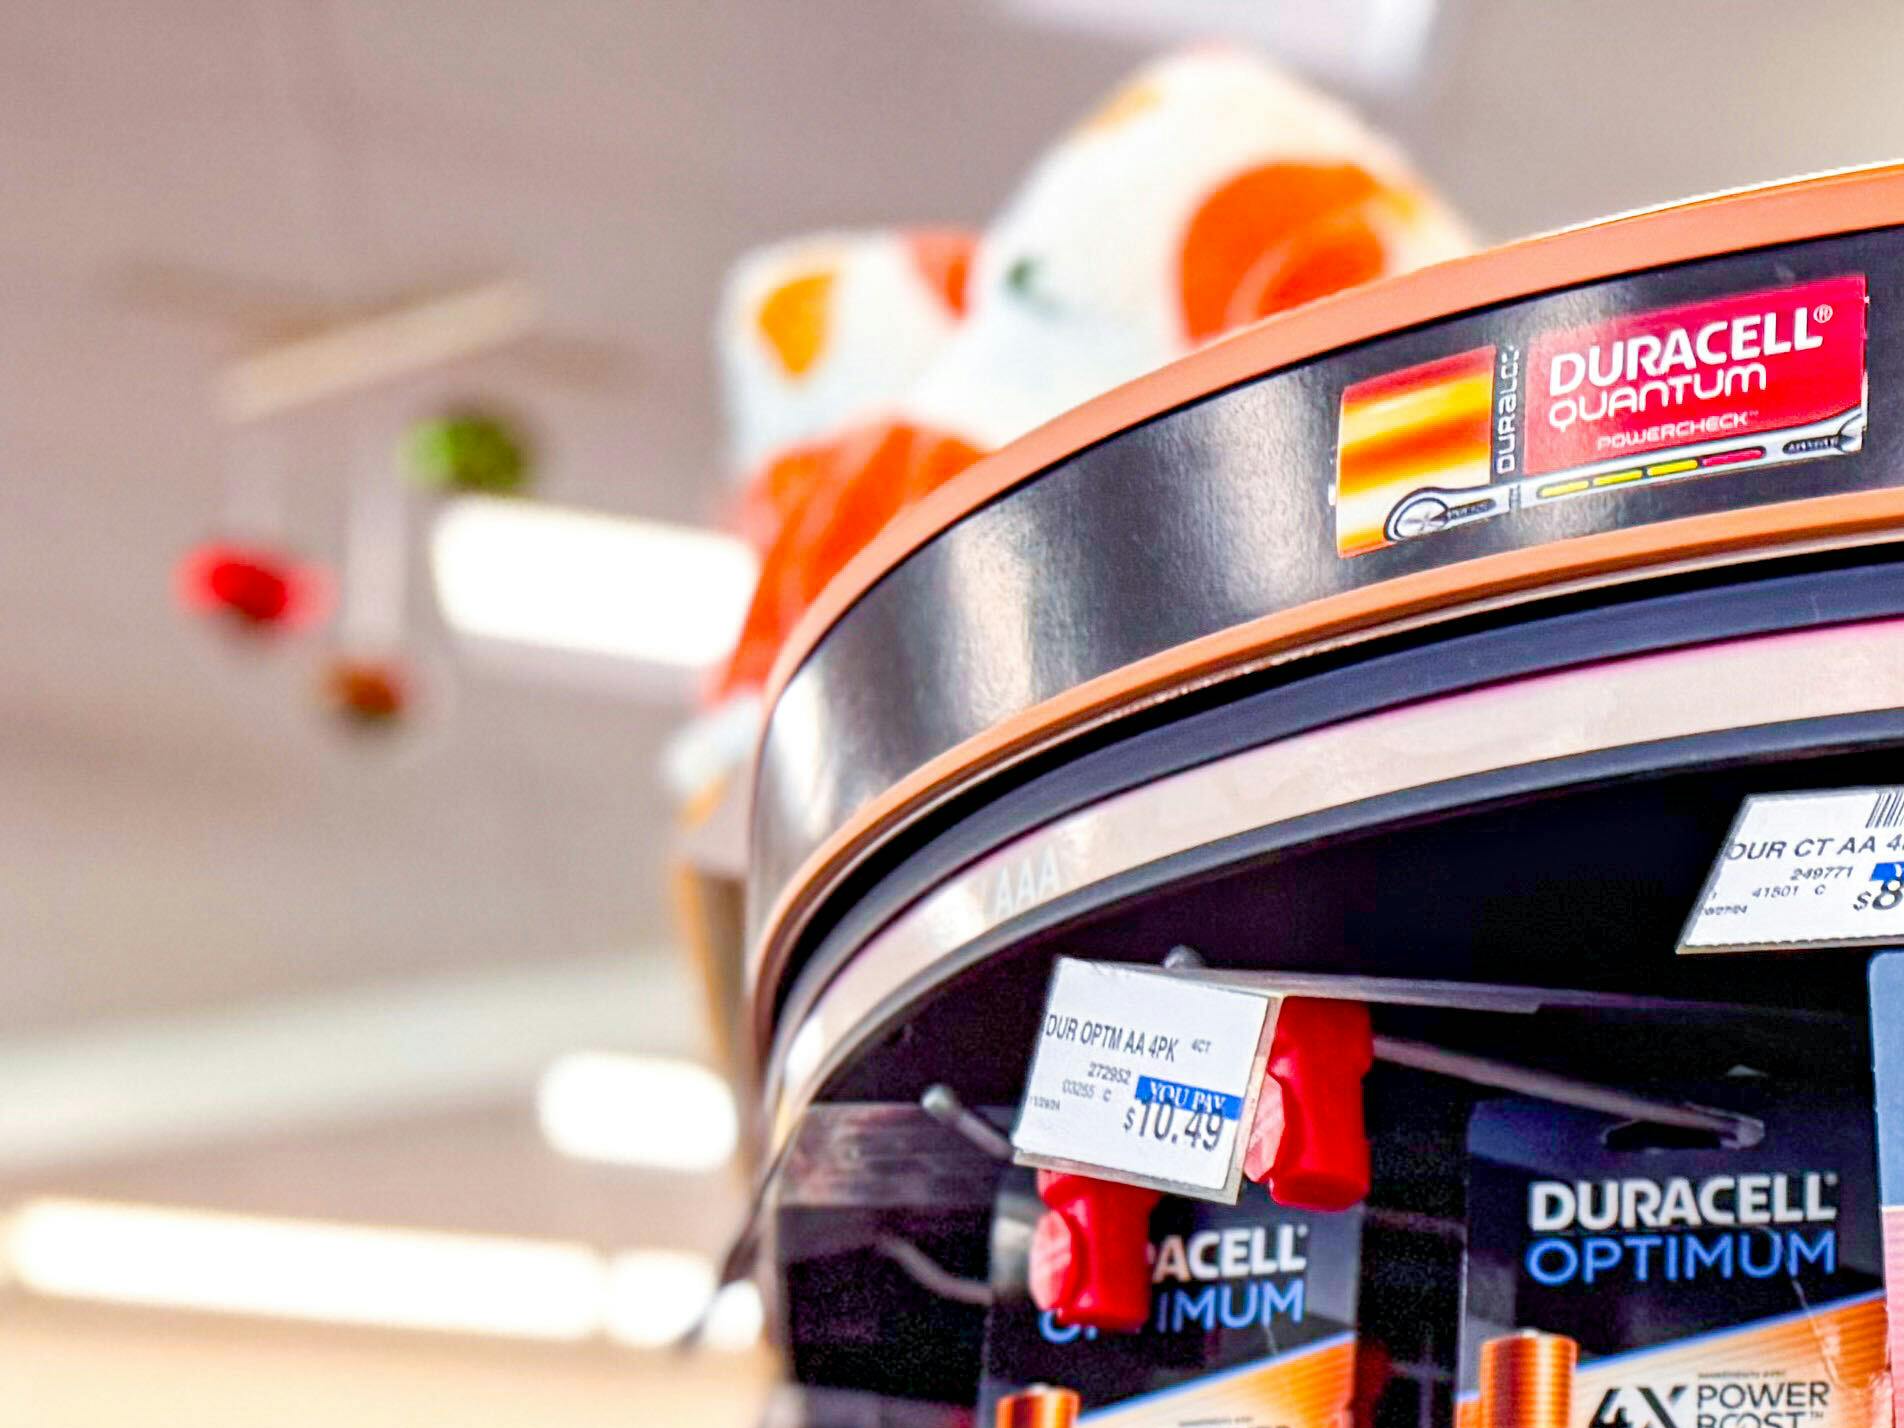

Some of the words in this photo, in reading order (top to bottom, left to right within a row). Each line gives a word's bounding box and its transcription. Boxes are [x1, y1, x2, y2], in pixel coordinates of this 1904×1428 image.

[1549, 308, 1822, 397] DURACELL
[1549, 362, 1766, 431] QUANTUM
[1598, 411, 1748, 450] POWERCHECK
[1795, 838, 1834, 858] CT
[1837, 835, 1876, 855] AA
[1045, 1014, 1076, 1042] DUR
[1079, 1020, 1121, 1052] OPTM
[1123, 1029, 1146, 1055] AA
[1148, 1034, 1179, 1063] 4PK
[1122, 1100, 1225, 1152] $10.49
[1530, 1173, 1836, 1231] DURACELL
[1525, 1231, 1836, 1286] OPTIMUM
[1697, 1382, 1829, 1408] POWER
